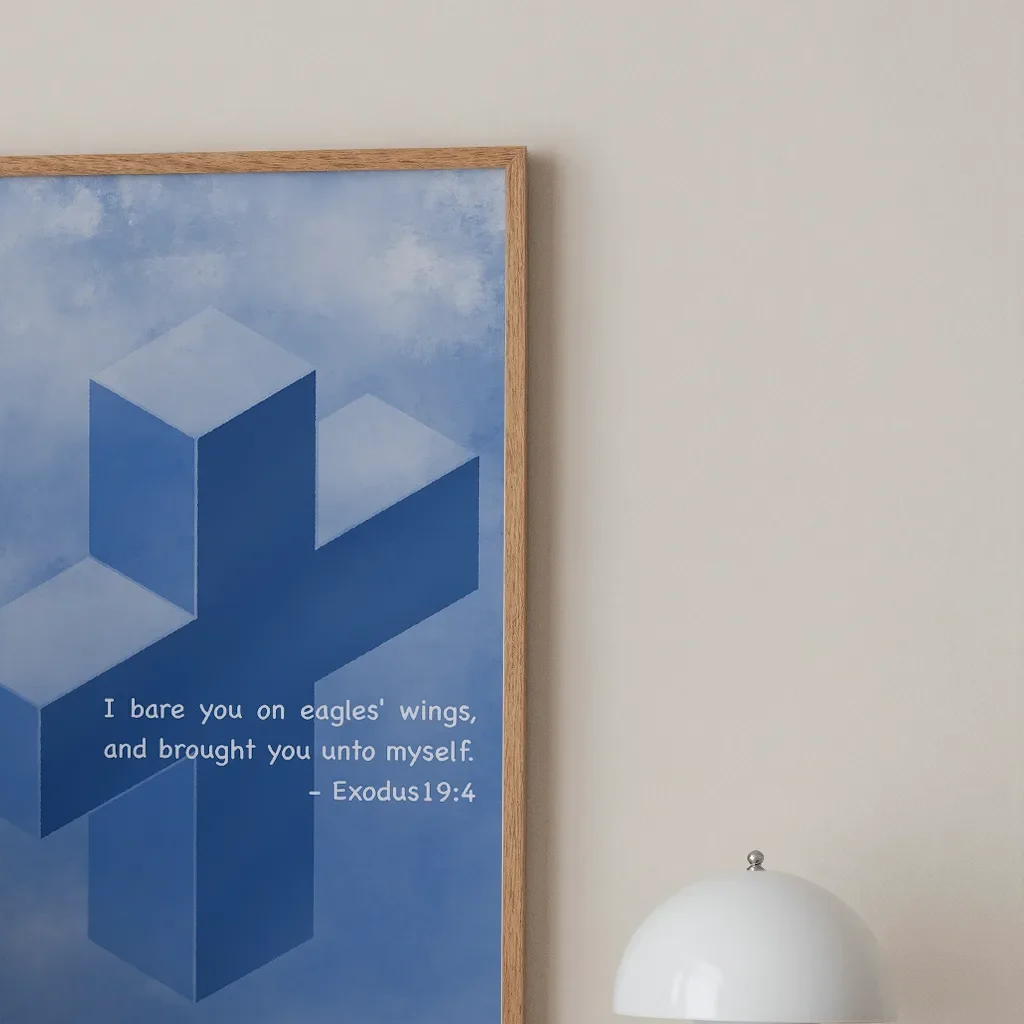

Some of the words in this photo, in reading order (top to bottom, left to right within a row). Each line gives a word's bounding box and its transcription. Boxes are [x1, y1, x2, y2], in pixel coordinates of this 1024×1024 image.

[104, 697, 115, 718] I
[130, 697, 185, 719] bare
[199, 703, 243, 725] you
[256, 704, 285, 721] on
[300, 697, 384, 727] eagles'
[399, 699, 477, 728] wings,
[103, 737, 147, 759] and
[159, 737, 257, 767] brought
[267, 744, 311, 766] you
[322, 739, 376, 762] unto
[386, 739, 474, 767] myself.
[332, 779, 476, 803] Exodus19:4
